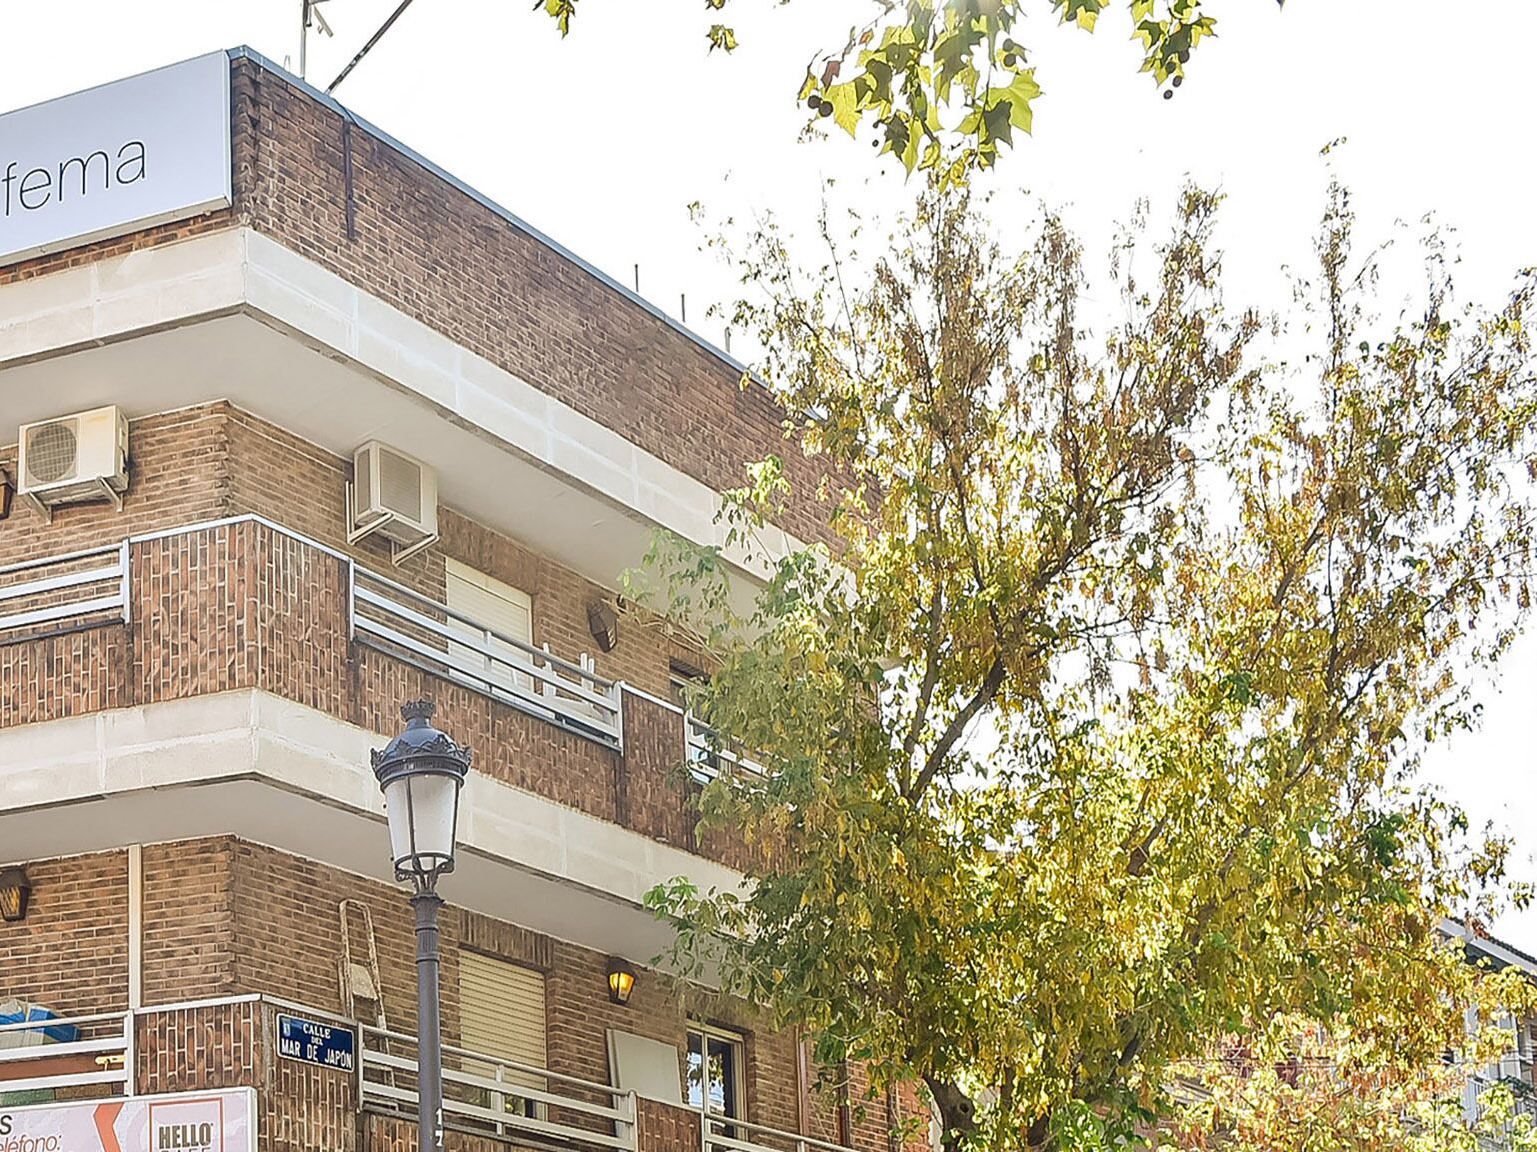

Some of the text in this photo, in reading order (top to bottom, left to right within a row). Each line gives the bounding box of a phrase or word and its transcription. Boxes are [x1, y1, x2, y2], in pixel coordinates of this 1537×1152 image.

[303, 1023, 331, 1039] CALLE
[281, 1038, 352, 1069] MAR DE JAPÓN
[158, 1123, 212, 1149] HELLO
